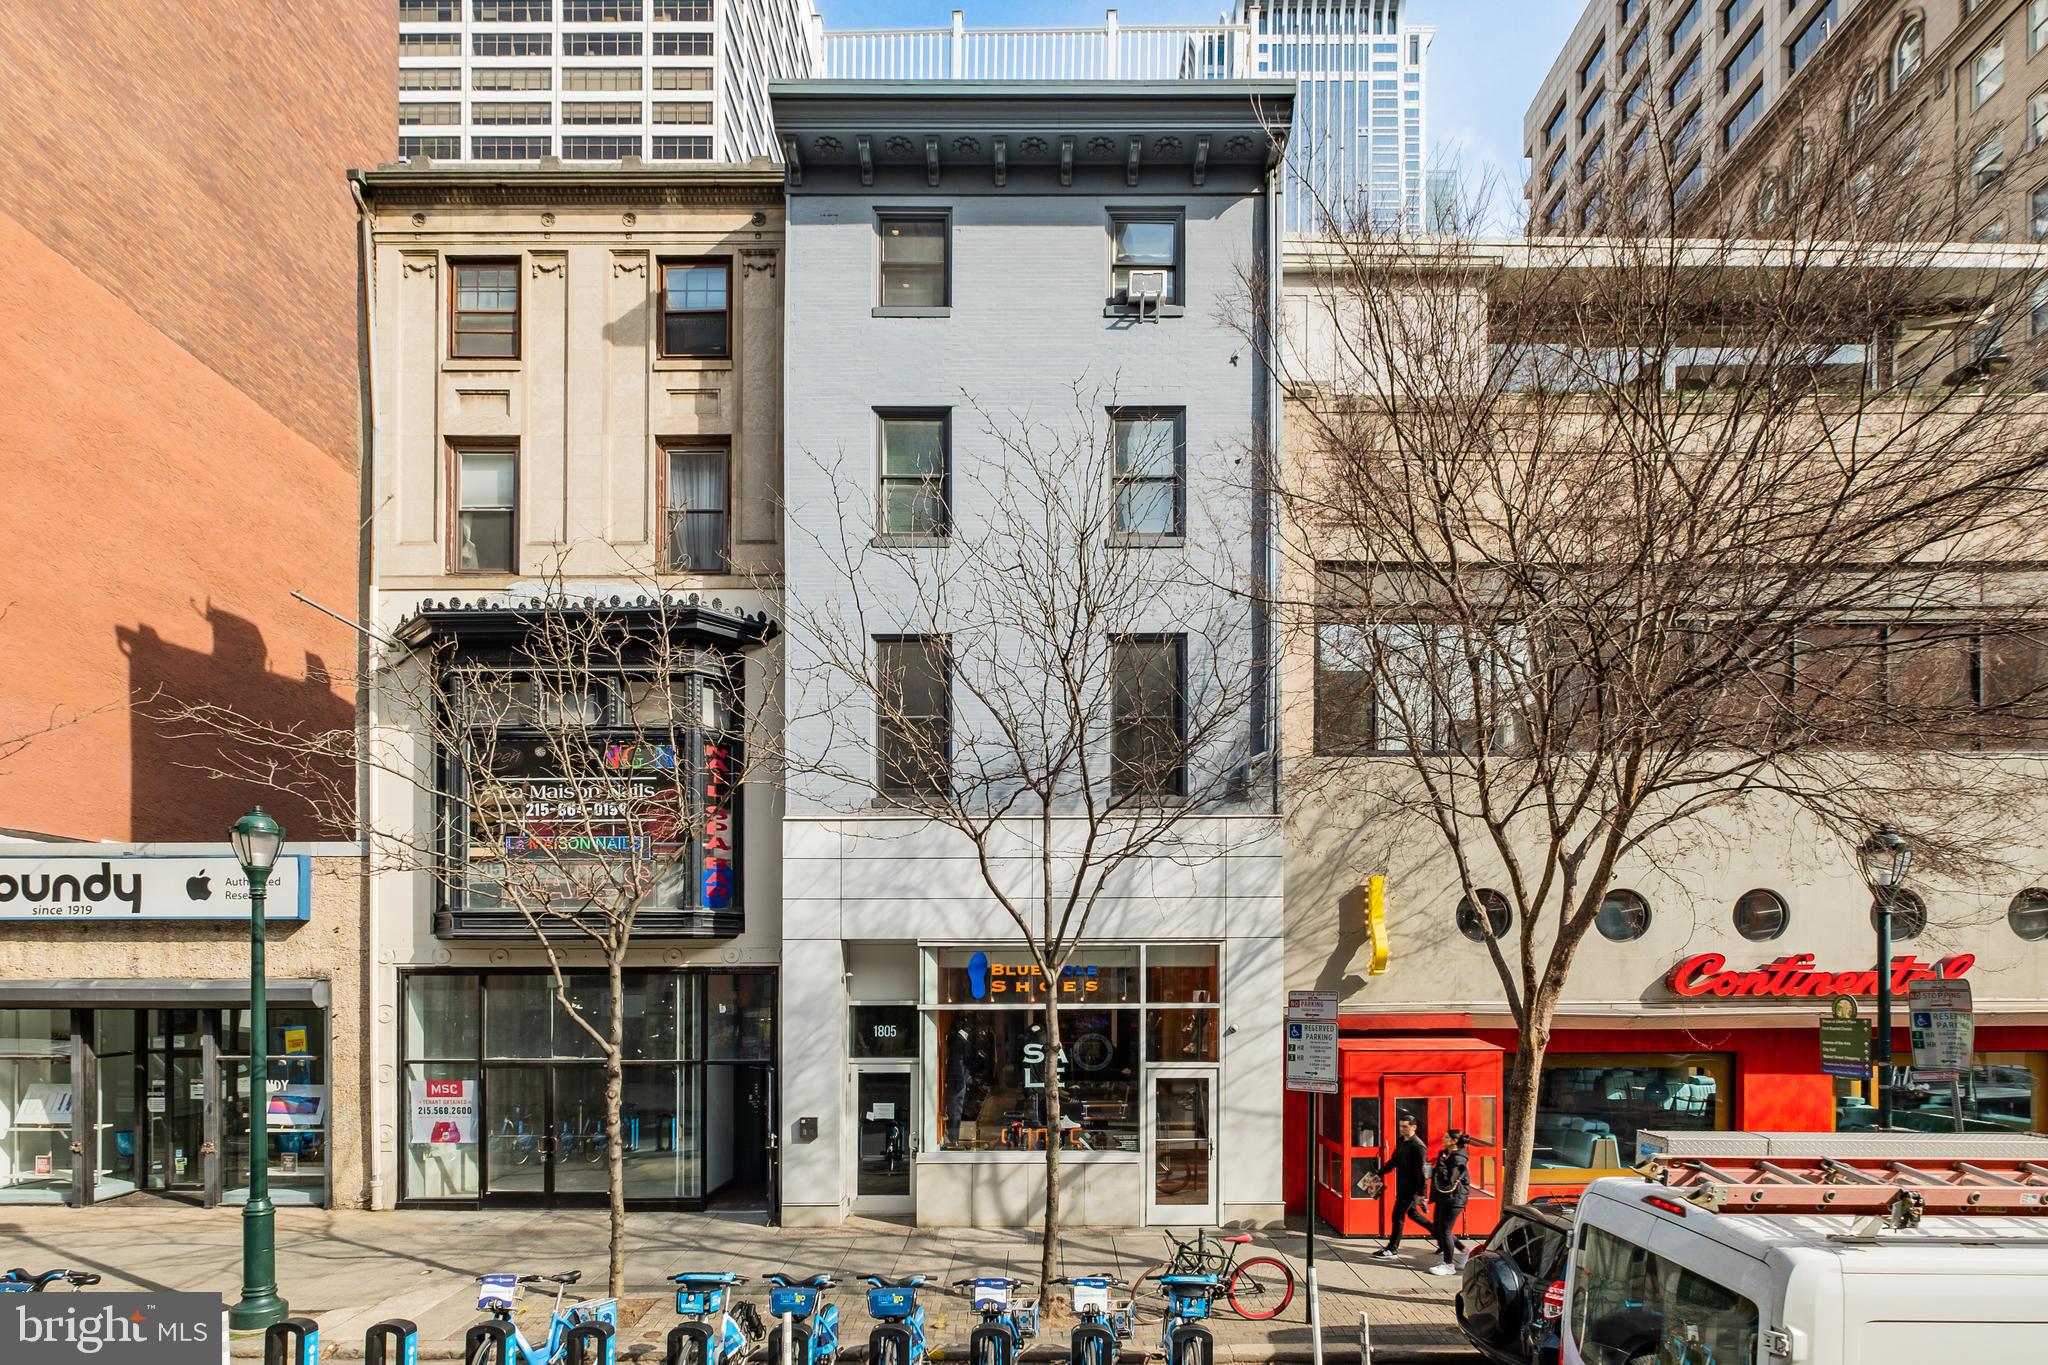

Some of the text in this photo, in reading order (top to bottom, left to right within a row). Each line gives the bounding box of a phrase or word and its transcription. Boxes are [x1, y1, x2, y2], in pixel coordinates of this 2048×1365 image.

[529, 784, 600, 800] Maison
[225, 877, 281, 887] Authed
[32, 905, 93, 915] since 1919
[991, 963, 1099, 976] BLUE OLE
[873, 1024, 897, 1038] 1805
[1304, 1024, 1335, 1032] RESERVED
[1305, 1033, 1333, 1041] PARKING
[431, 1084, 458, 1095] MSC
[418, 1106, 473, 1115] 215.568.2600
